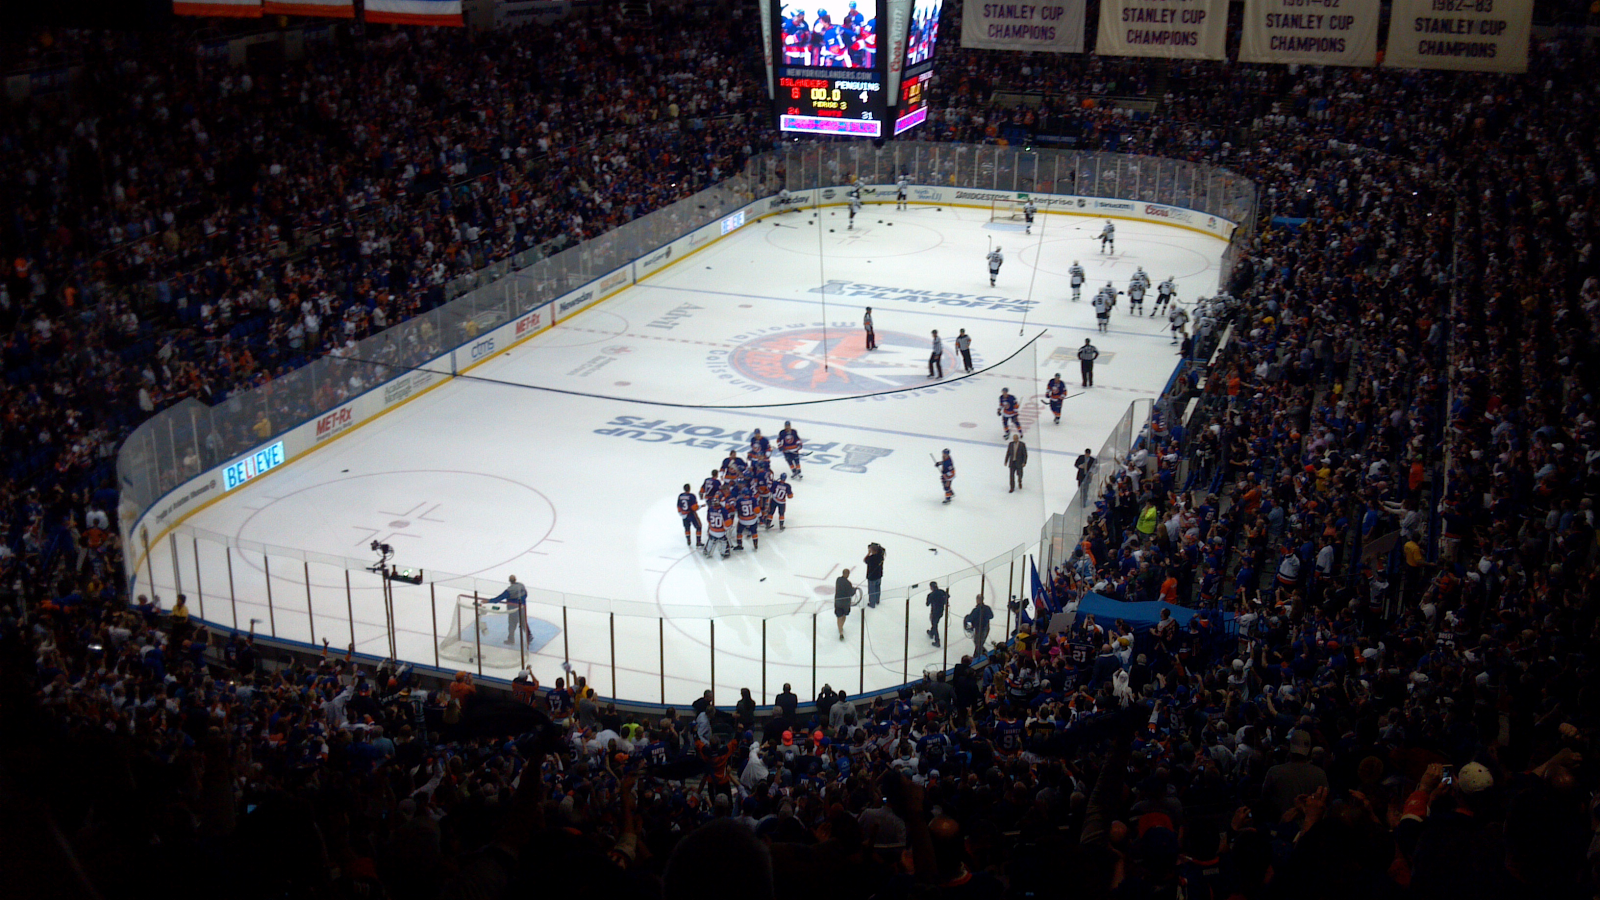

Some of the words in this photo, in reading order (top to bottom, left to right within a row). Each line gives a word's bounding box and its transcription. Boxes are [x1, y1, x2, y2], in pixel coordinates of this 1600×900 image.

[984, 4, 1036, 19] STANLEY
[1042, 6, 1064, 20] CUP
[1122, 8, 1177, 23] STANLEY
[1182, 10, 1206, 24] CUP
[1266, 13, 1323, 29] STANLEY
[1329, 15, 1354, 30] CUP
[1415, 17, 1474, 34] STANLEY
[1480, 20, 1507, 36] CUP
[988, 24, 1056, 40] CHAMPIONS
[1127, 29, 1198, 45] CHAMPIONS
[1270, 35, 1346, 52] CHAMPIONS
[1419, 40, 1497, 58] CHAMPIONS
[780, 77, 828, 88] ISLANDERS
[834, 80, 880, 91] PENGUINS
[811, 88, 841, 101] 00.0
[859, 91, 868, 103] 4
[840, 102, 848, 110] 3
[861, 111, 873, 120] 31
[955, 191, 1011, 201] BRIDGESTONE
[847, 283, 975, 299] STANLEY
[975, 295, 1040, 305] CUP
[848, 290, 1036, 313] PLAYOFFS
[316, 407, 352, 436] MET-Rx
[593, 428, 672, 443] CUP
[227, 444, 280, 489] BELIEVE
[774, 488, 786, 499] 10
[681, 499, 689, 511] 3
[742, 504, 754, 516] 91
[709, 516, 722, 528] 20
